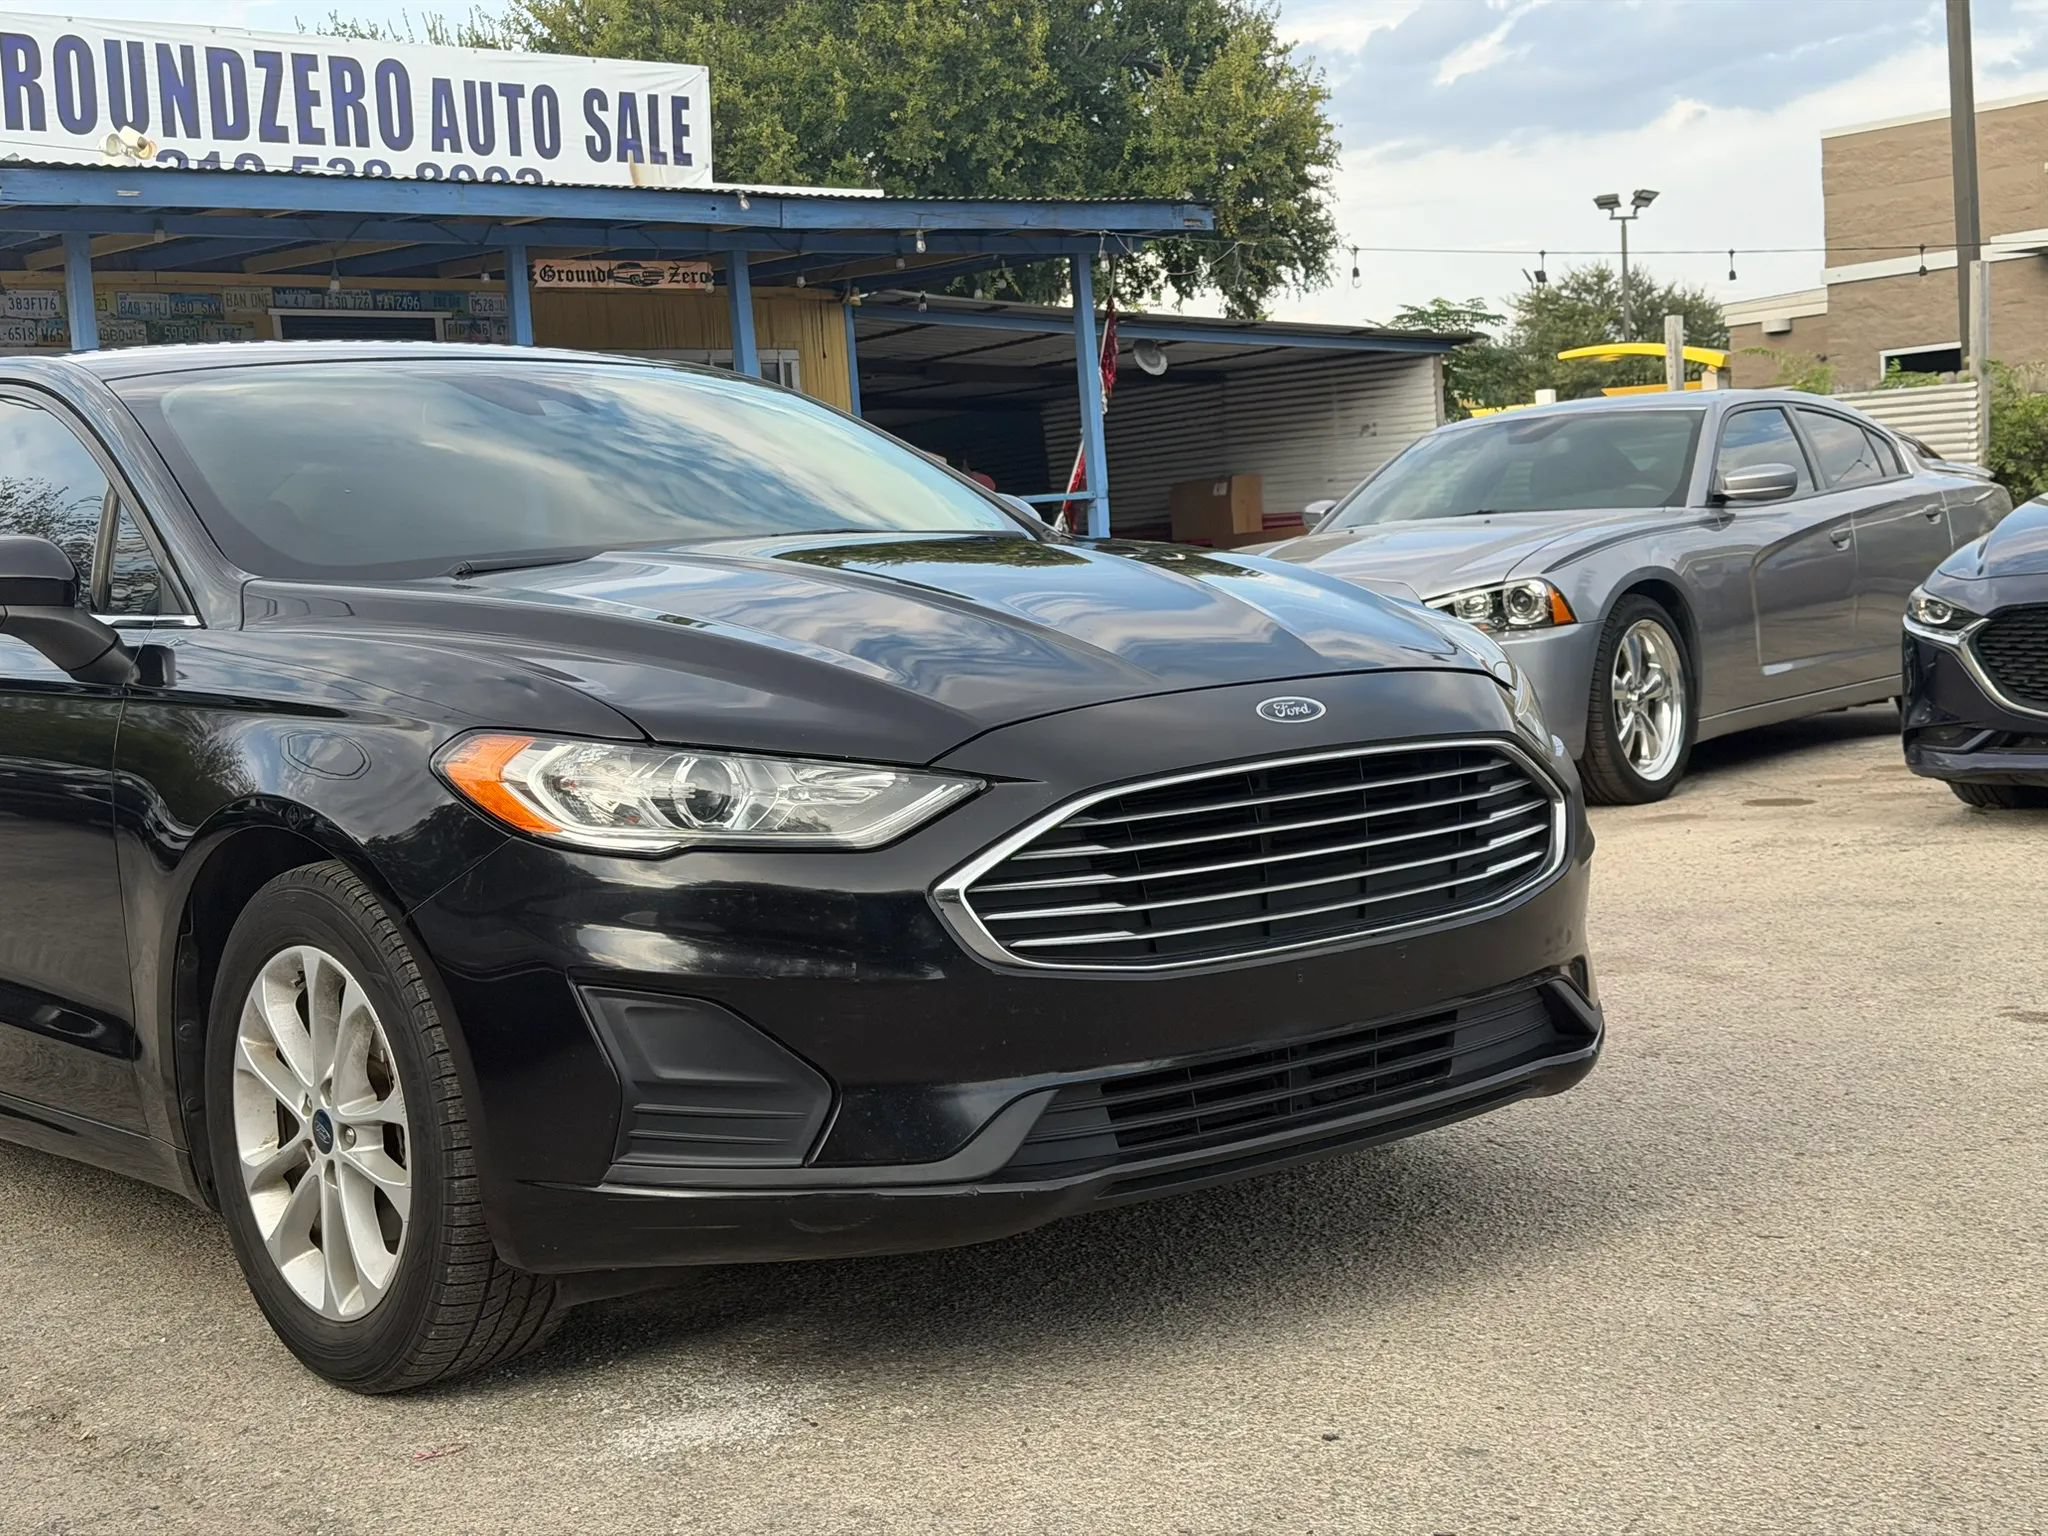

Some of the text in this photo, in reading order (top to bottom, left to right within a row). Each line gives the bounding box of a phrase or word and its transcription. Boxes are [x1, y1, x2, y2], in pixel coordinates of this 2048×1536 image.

[431, 77, 561, 160] AUTO
[583, 87, 693, 167] SALE
[539, 264, 709, 284] Ground Zero
[8, 297, 57, 310] 383F176
[1272, 701, 1312, 717] Ford
